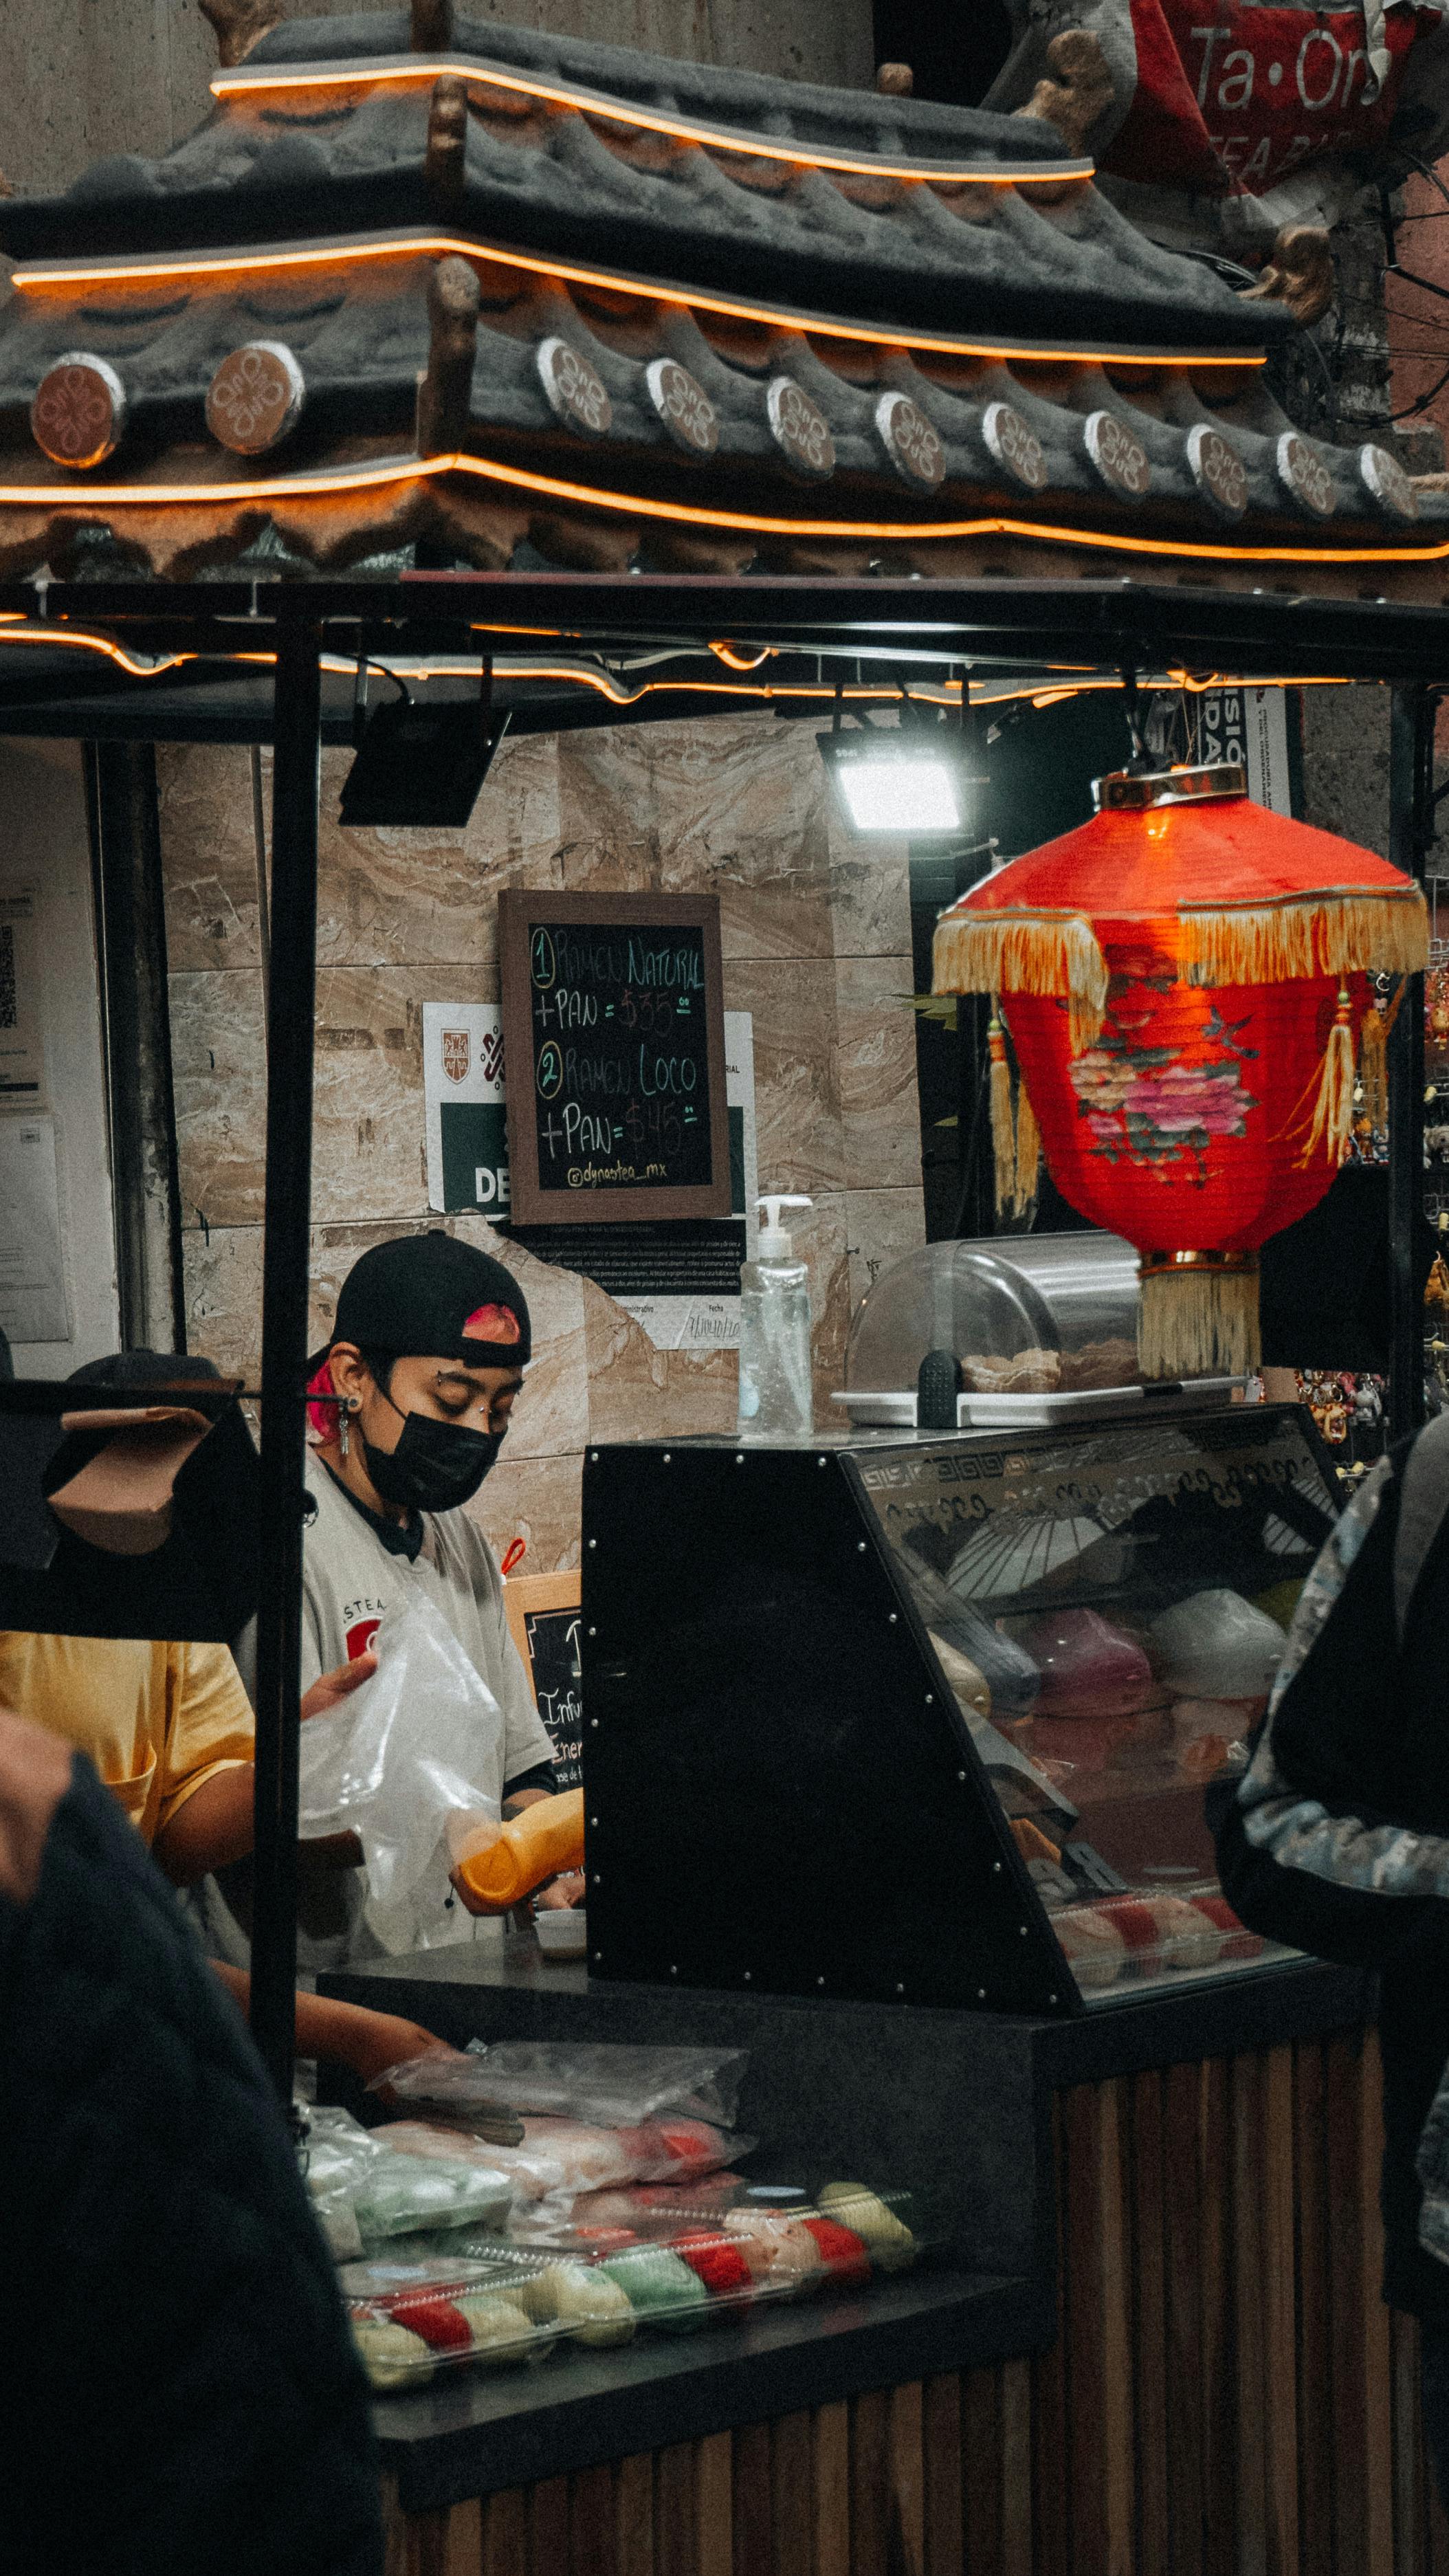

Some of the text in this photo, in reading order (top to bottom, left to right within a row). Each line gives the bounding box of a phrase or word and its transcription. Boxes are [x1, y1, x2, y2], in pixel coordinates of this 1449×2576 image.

[639, 1043, 698, 1096] LOCO
[709, 1303, 724, 1312] Fecha
[342, 1598, 386, 1625] STEA
[538, 1688, 583, 1726] Infu
